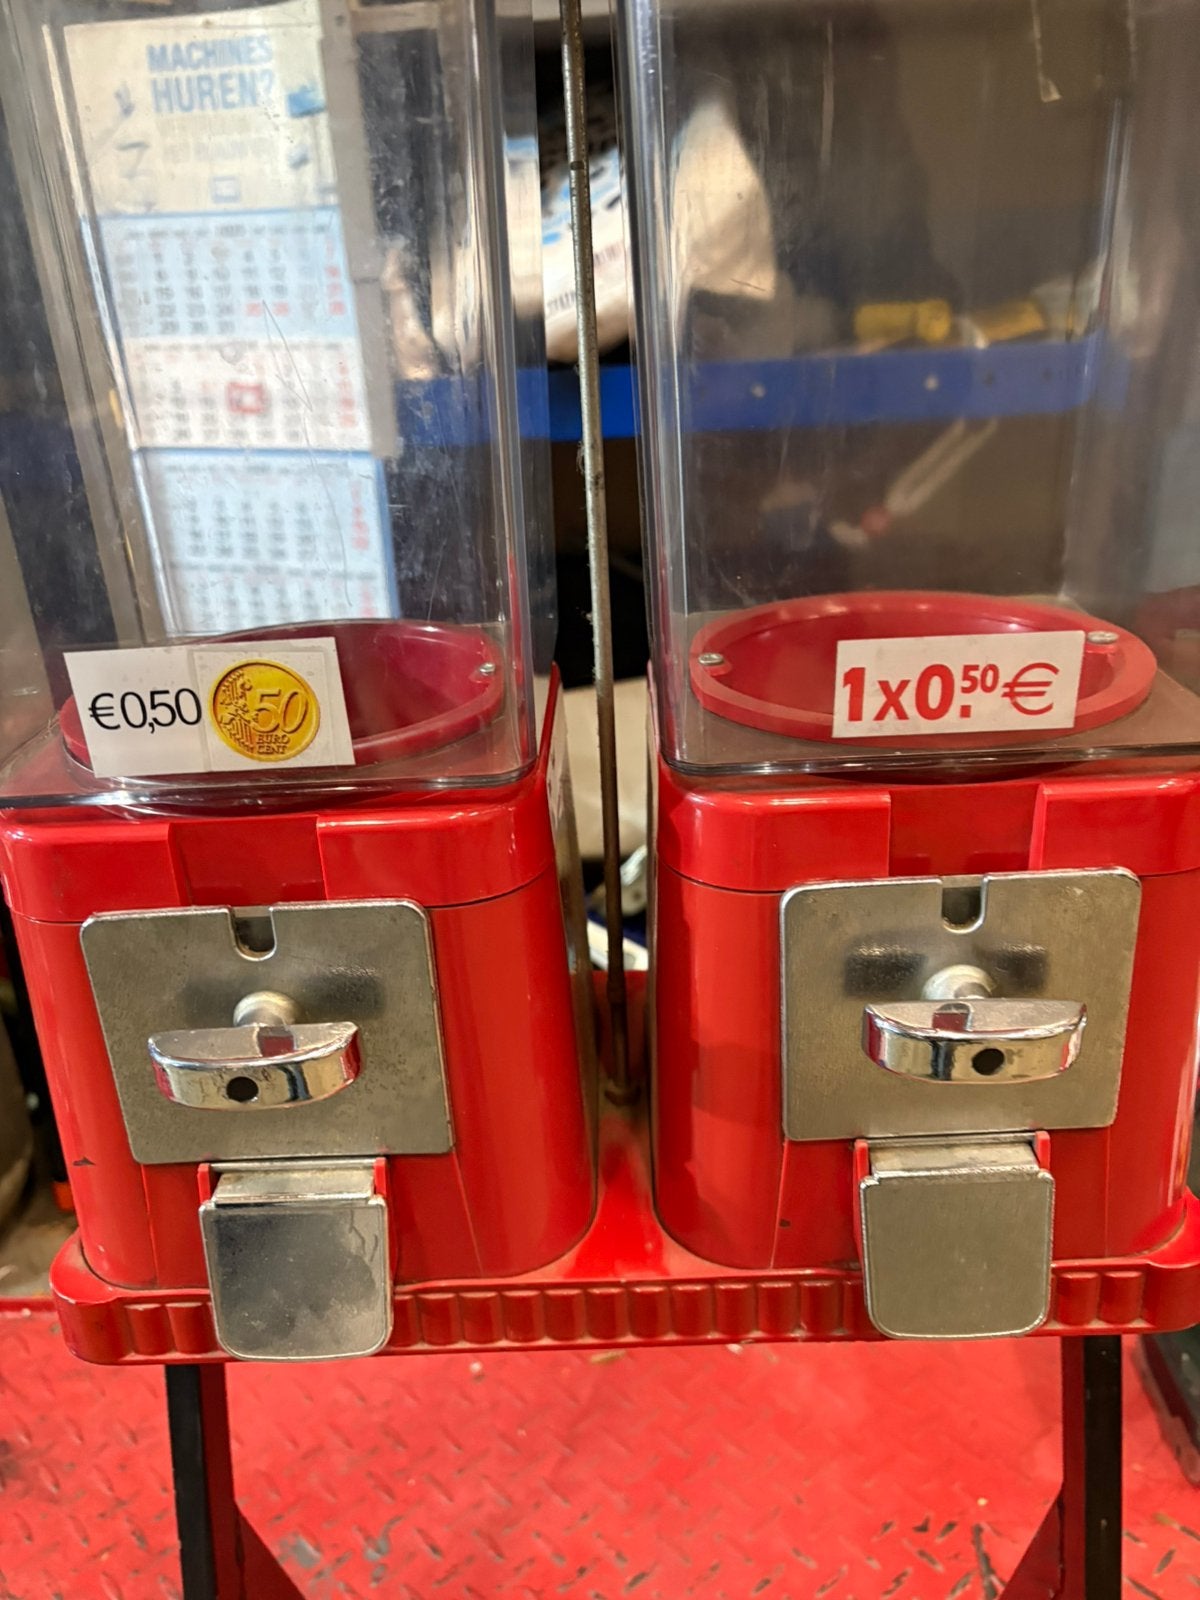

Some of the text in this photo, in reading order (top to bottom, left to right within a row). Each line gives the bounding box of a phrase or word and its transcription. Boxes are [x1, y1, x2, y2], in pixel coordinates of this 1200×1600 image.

[146, 34, 273, 72] MACHINES
[151, 69, 274, 113] HUREN?
[88, 687, 203, 734] €0,50
[251, 688, 310, 735] 50
[255, 734, 291, 745] EURO
[256, 744, 289, 756] CENT
